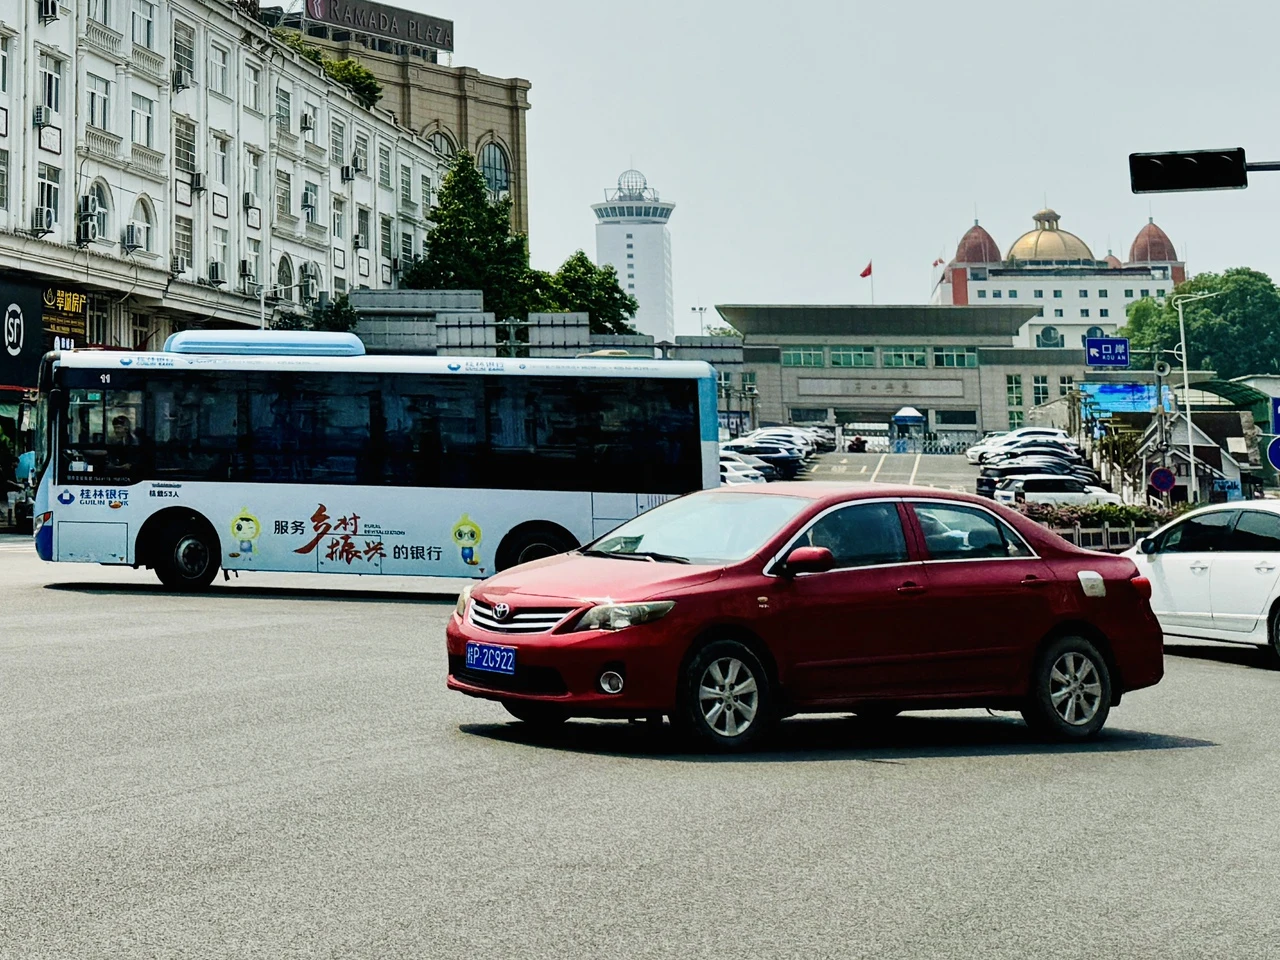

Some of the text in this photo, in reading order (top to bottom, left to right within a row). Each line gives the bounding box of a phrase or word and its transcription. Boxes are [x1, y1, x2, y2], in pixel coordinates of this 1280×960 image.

[408, 20, 453, 45] PLAZA
[1102, 343, 1125, 355] 口岸
[79, 489, 129, 501] 桂林银行
[274, 520, 306, 535] 服务
[393, 544, 443, 561] 的银行
